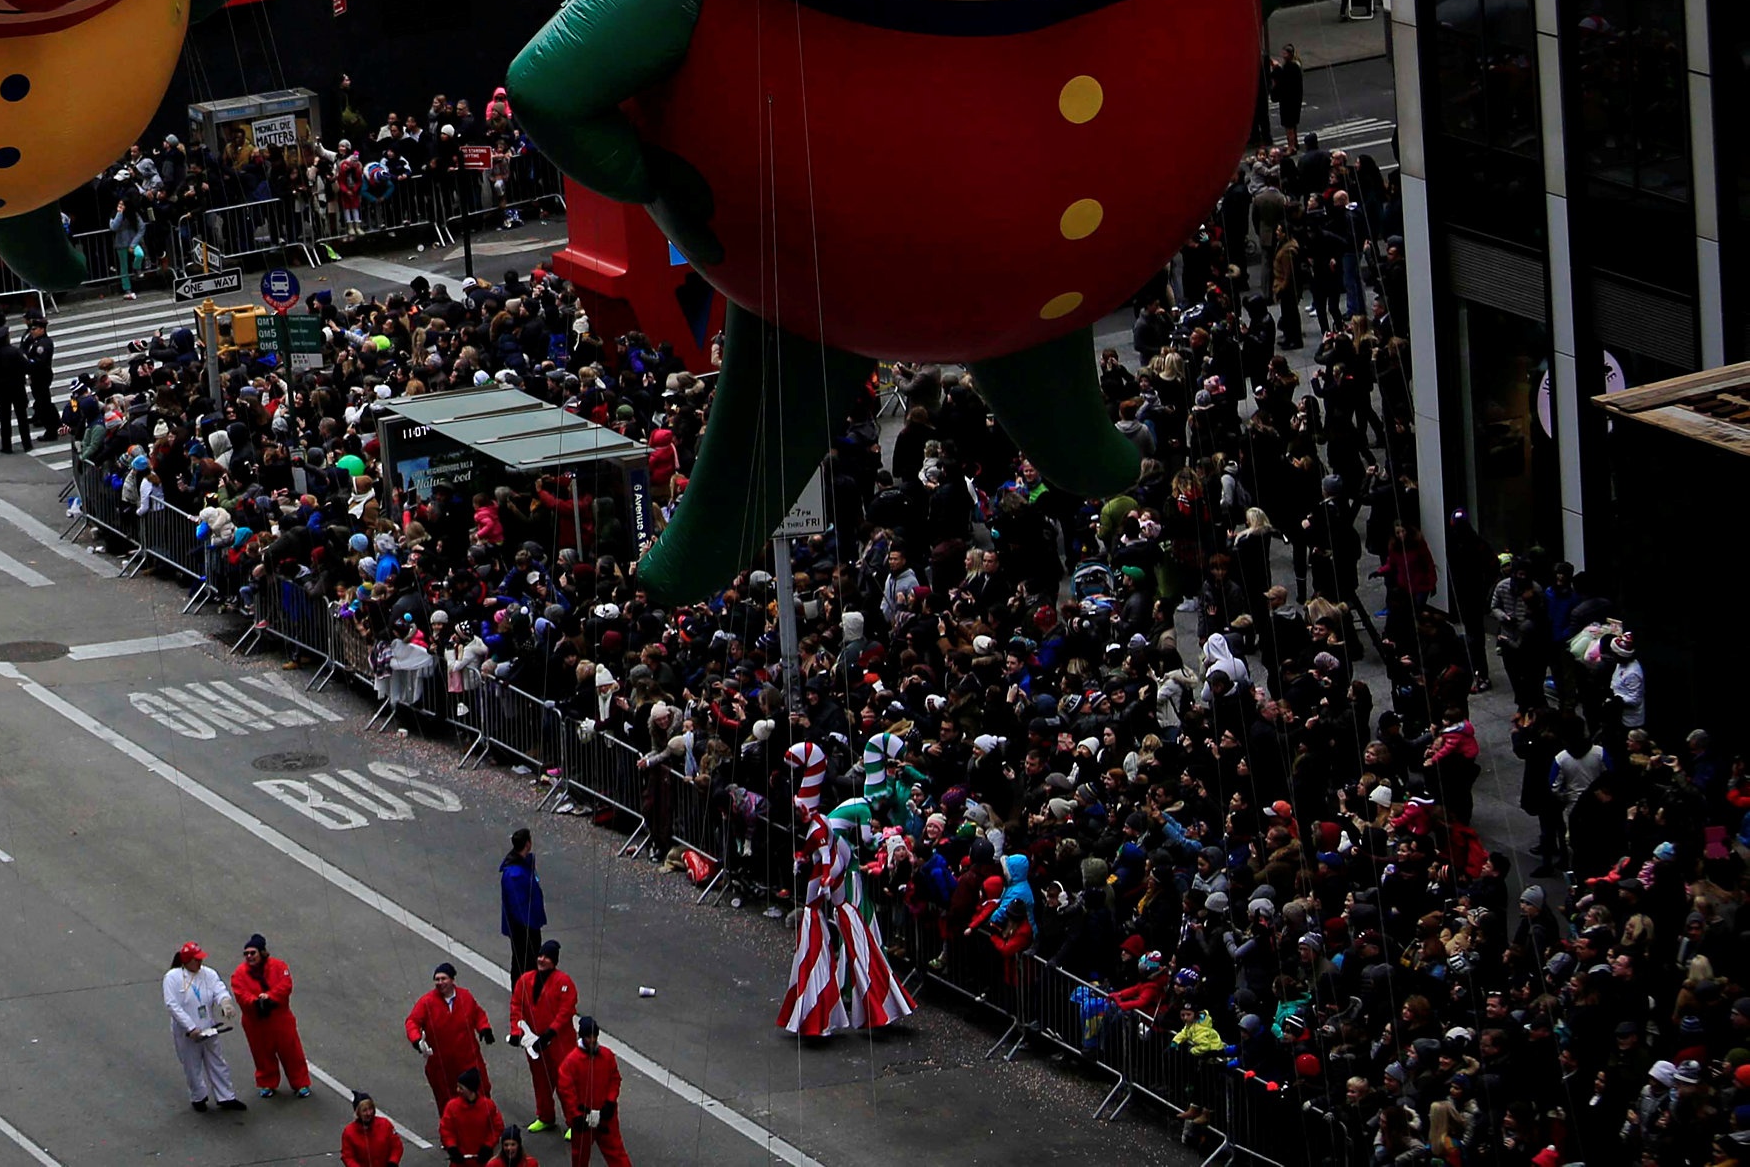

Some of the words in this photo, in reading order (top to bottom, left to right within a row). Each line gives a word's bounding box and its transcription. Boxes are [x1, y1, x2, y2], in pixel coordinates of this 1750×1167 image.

[183, 283, 203, 294] ONE
[214, 276, 236, 288] WAY
[258, 328, 277, 338] QM5
[259, 340, 278, 350] QM6
[634, 493, 644, 531] Avenue
[805, 518, 820, 527] FRI
[637, 532, 646, 540] &
[127, 671, 345, 740] ONLY
[252, 760, 464, 831] BUS
